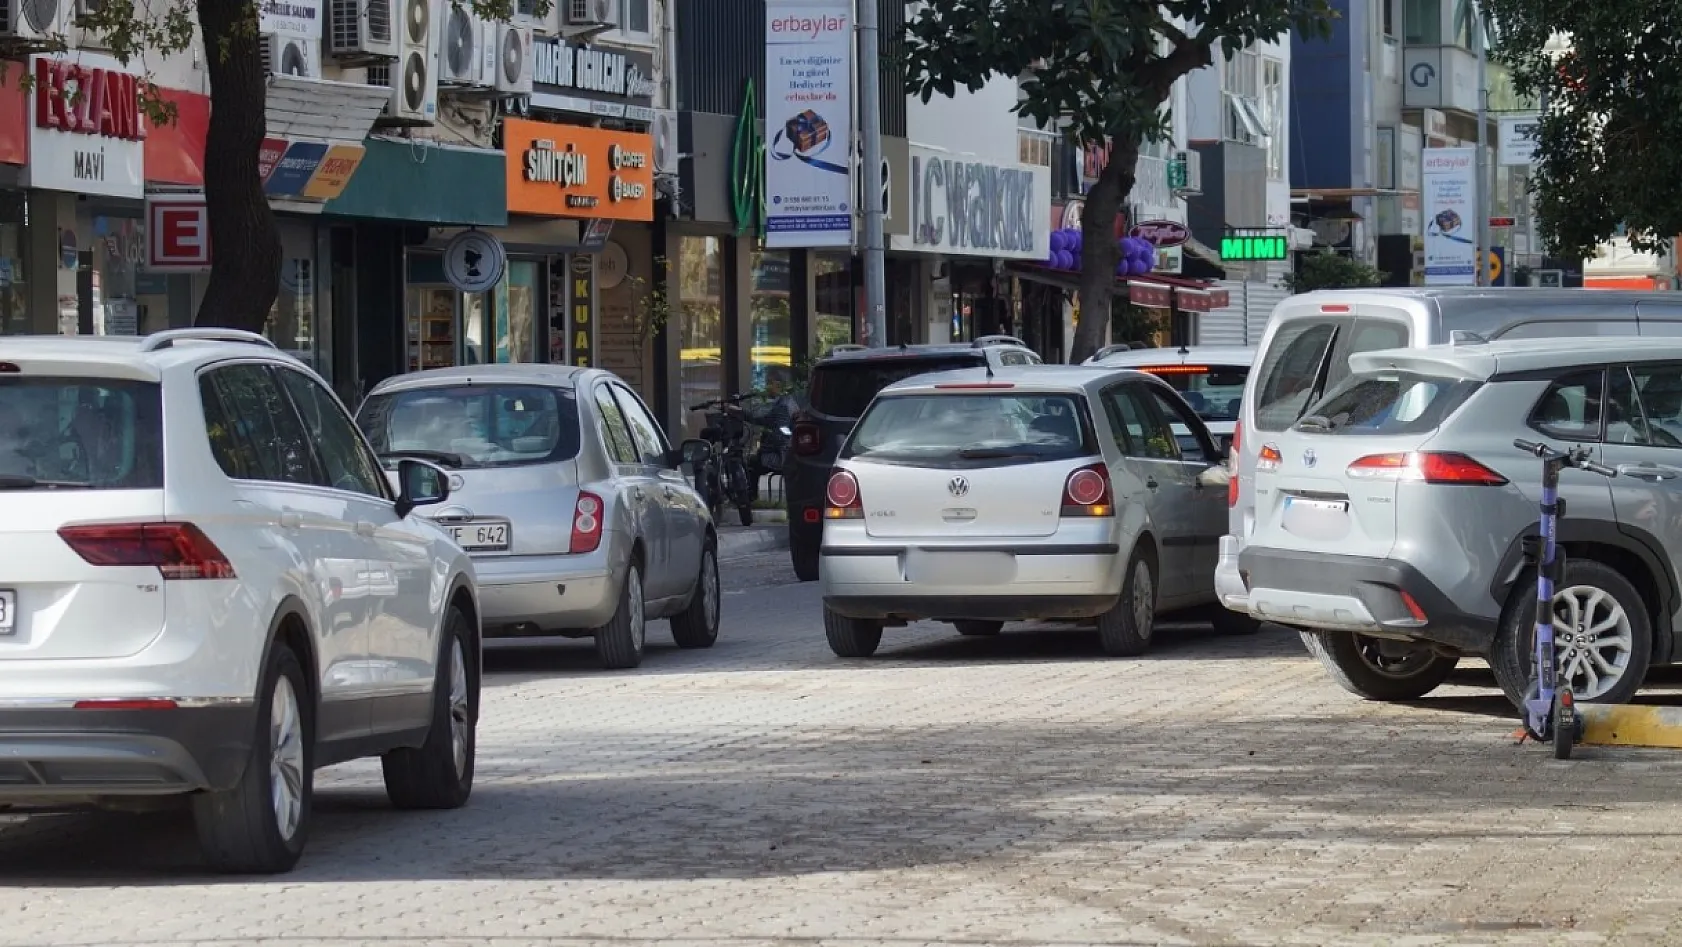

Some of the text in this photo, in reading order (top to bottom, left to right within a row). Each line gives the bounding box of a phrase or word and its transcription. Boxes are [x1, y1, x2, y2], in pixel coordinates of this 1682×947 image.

[771, 14, 846, 39] erbaylar
[74, 145, 105, 181] MAVİ
[163, 210, 201, 257] E
[1221, 238, 1284, 259] MIMI
[477, 526, 504, 543] 642
[136, 584, 159, 592] TSI
